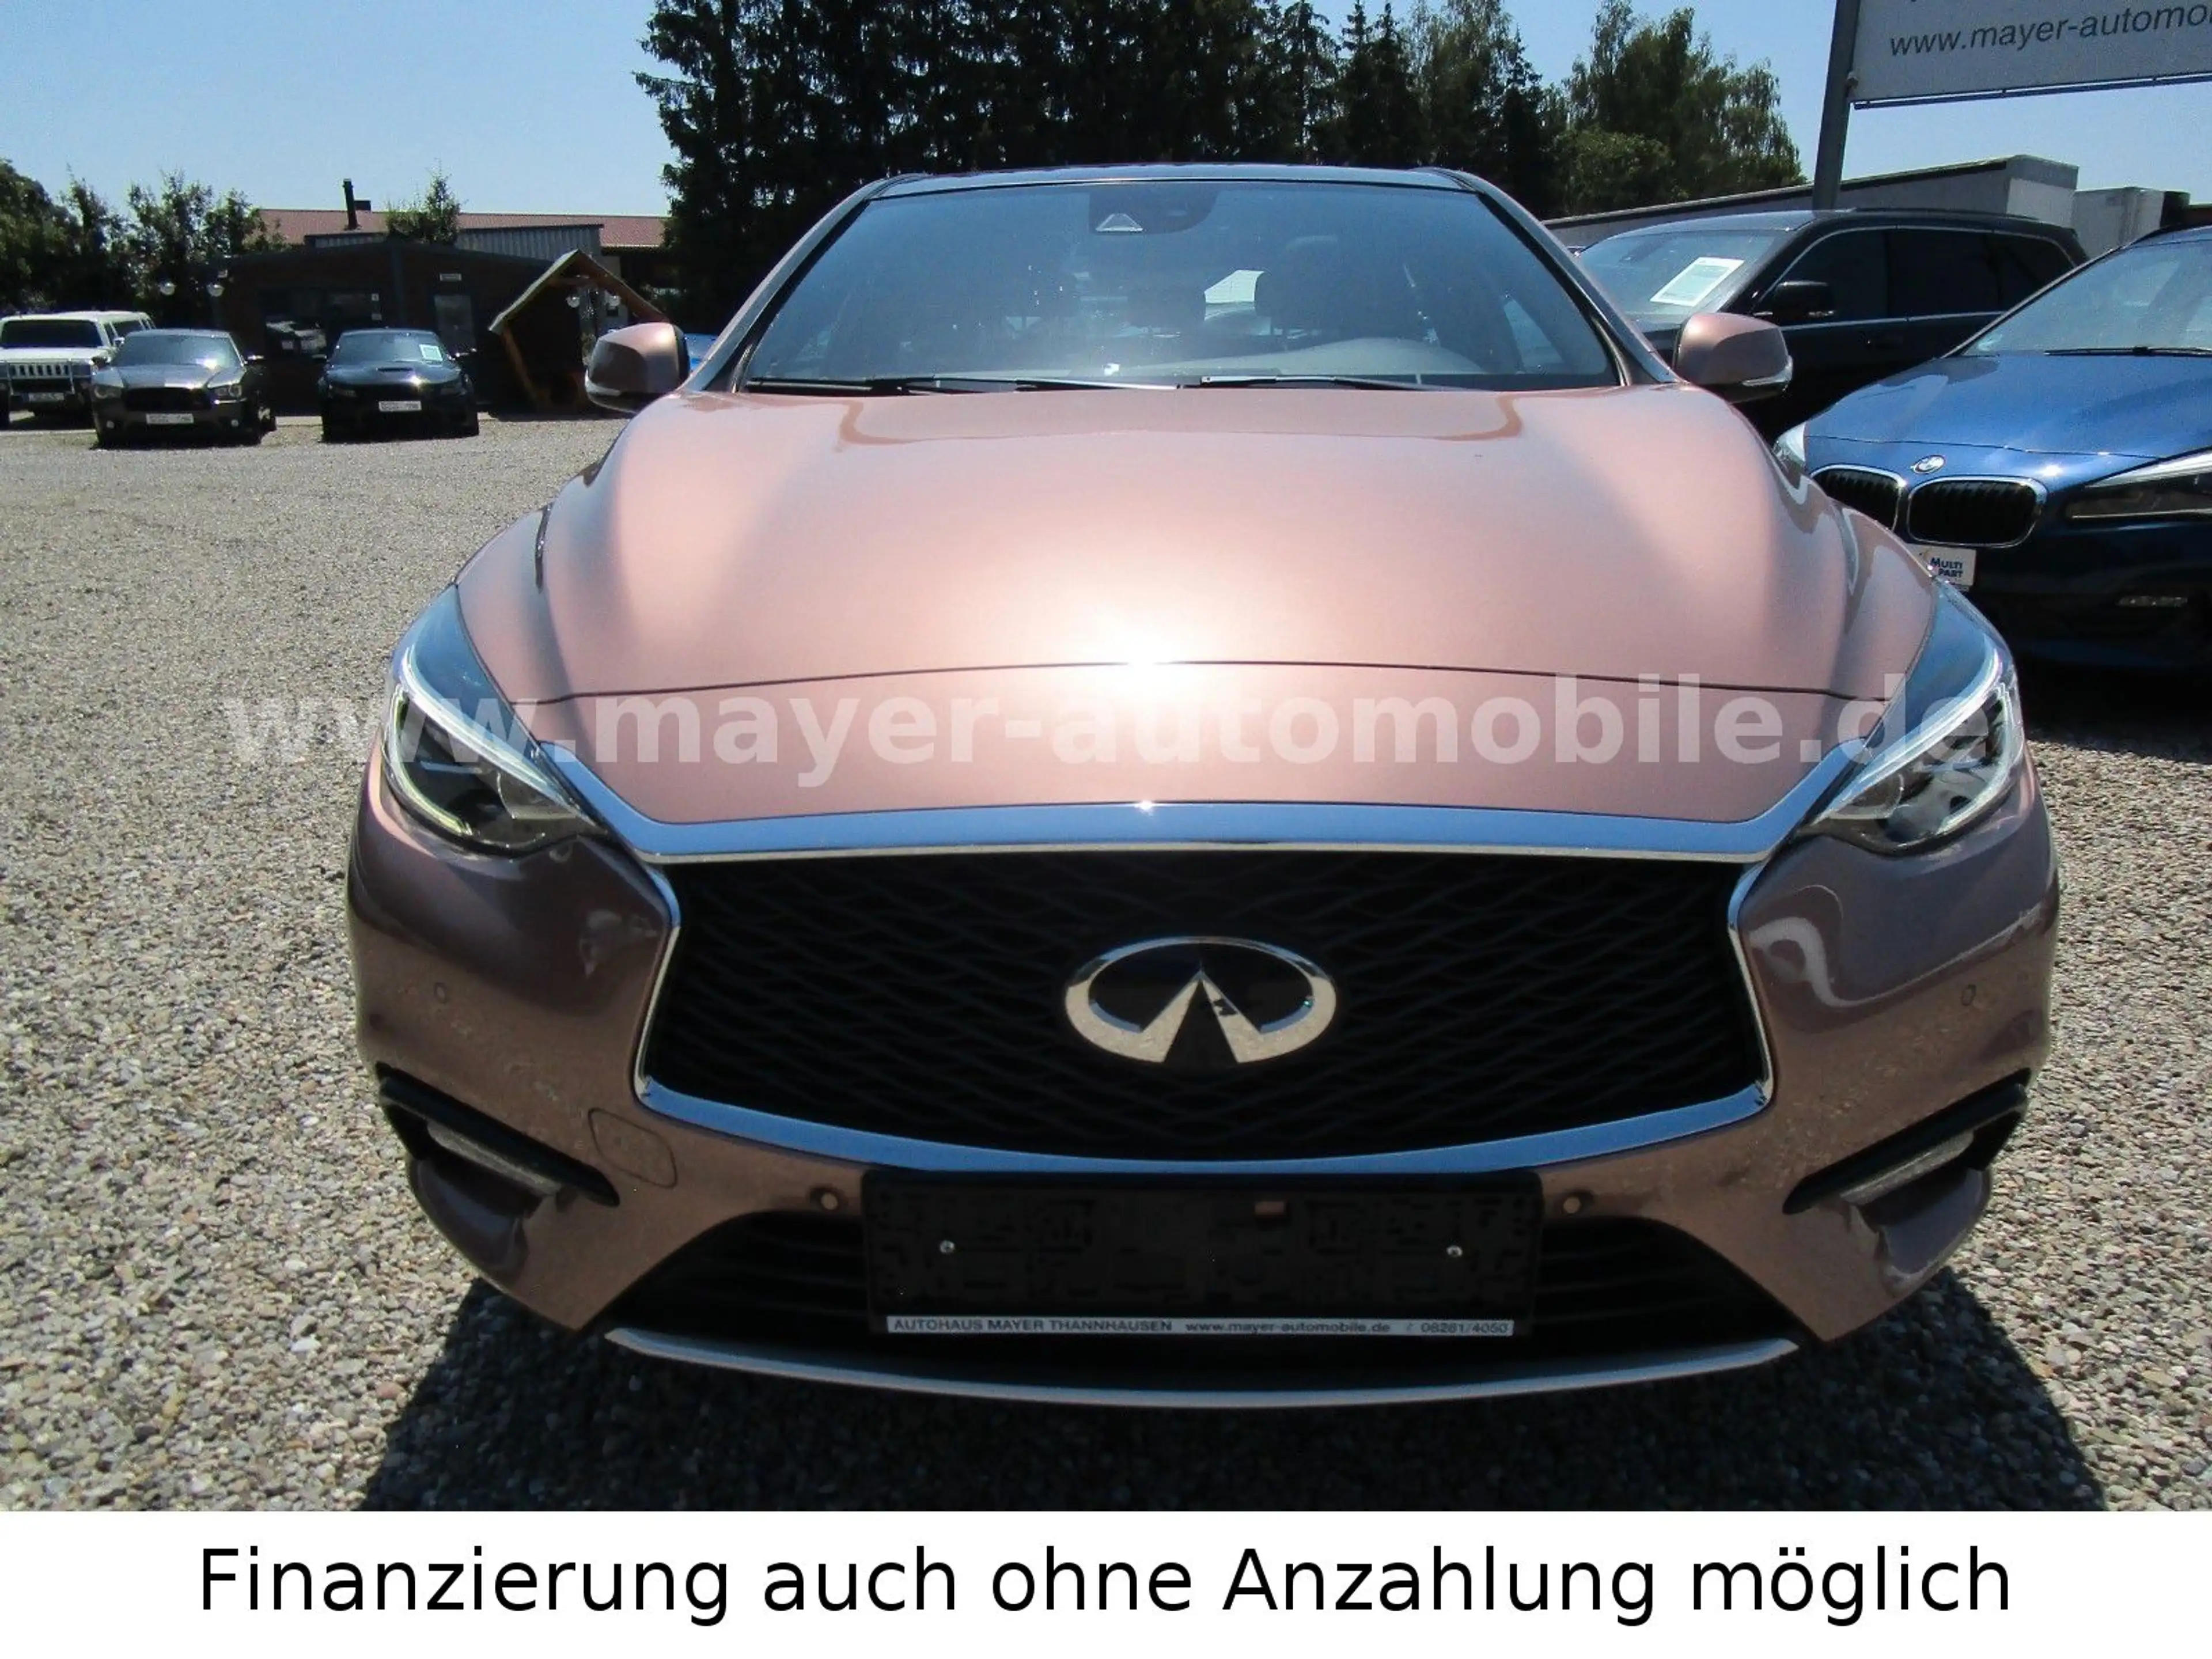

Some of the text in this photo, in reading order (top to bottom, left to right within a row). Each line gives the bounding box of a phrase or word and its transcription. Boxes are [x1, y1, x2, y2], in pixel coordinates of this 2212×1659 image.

[1890, 3, 2212, 56] www.mayer-automo
[1930, 557, 1963, 569] MULTI
[1938, 568, 1963, 578] PART
[894, 1319, 982, 1332] AUTOHAUS
[988, 1319, 1043, 1332] MAYER
[1050, 1319, 1172, 1332] THANNHAUSEN
[1185, 1321, 1390, 1334] www.mayer-automobile.de
